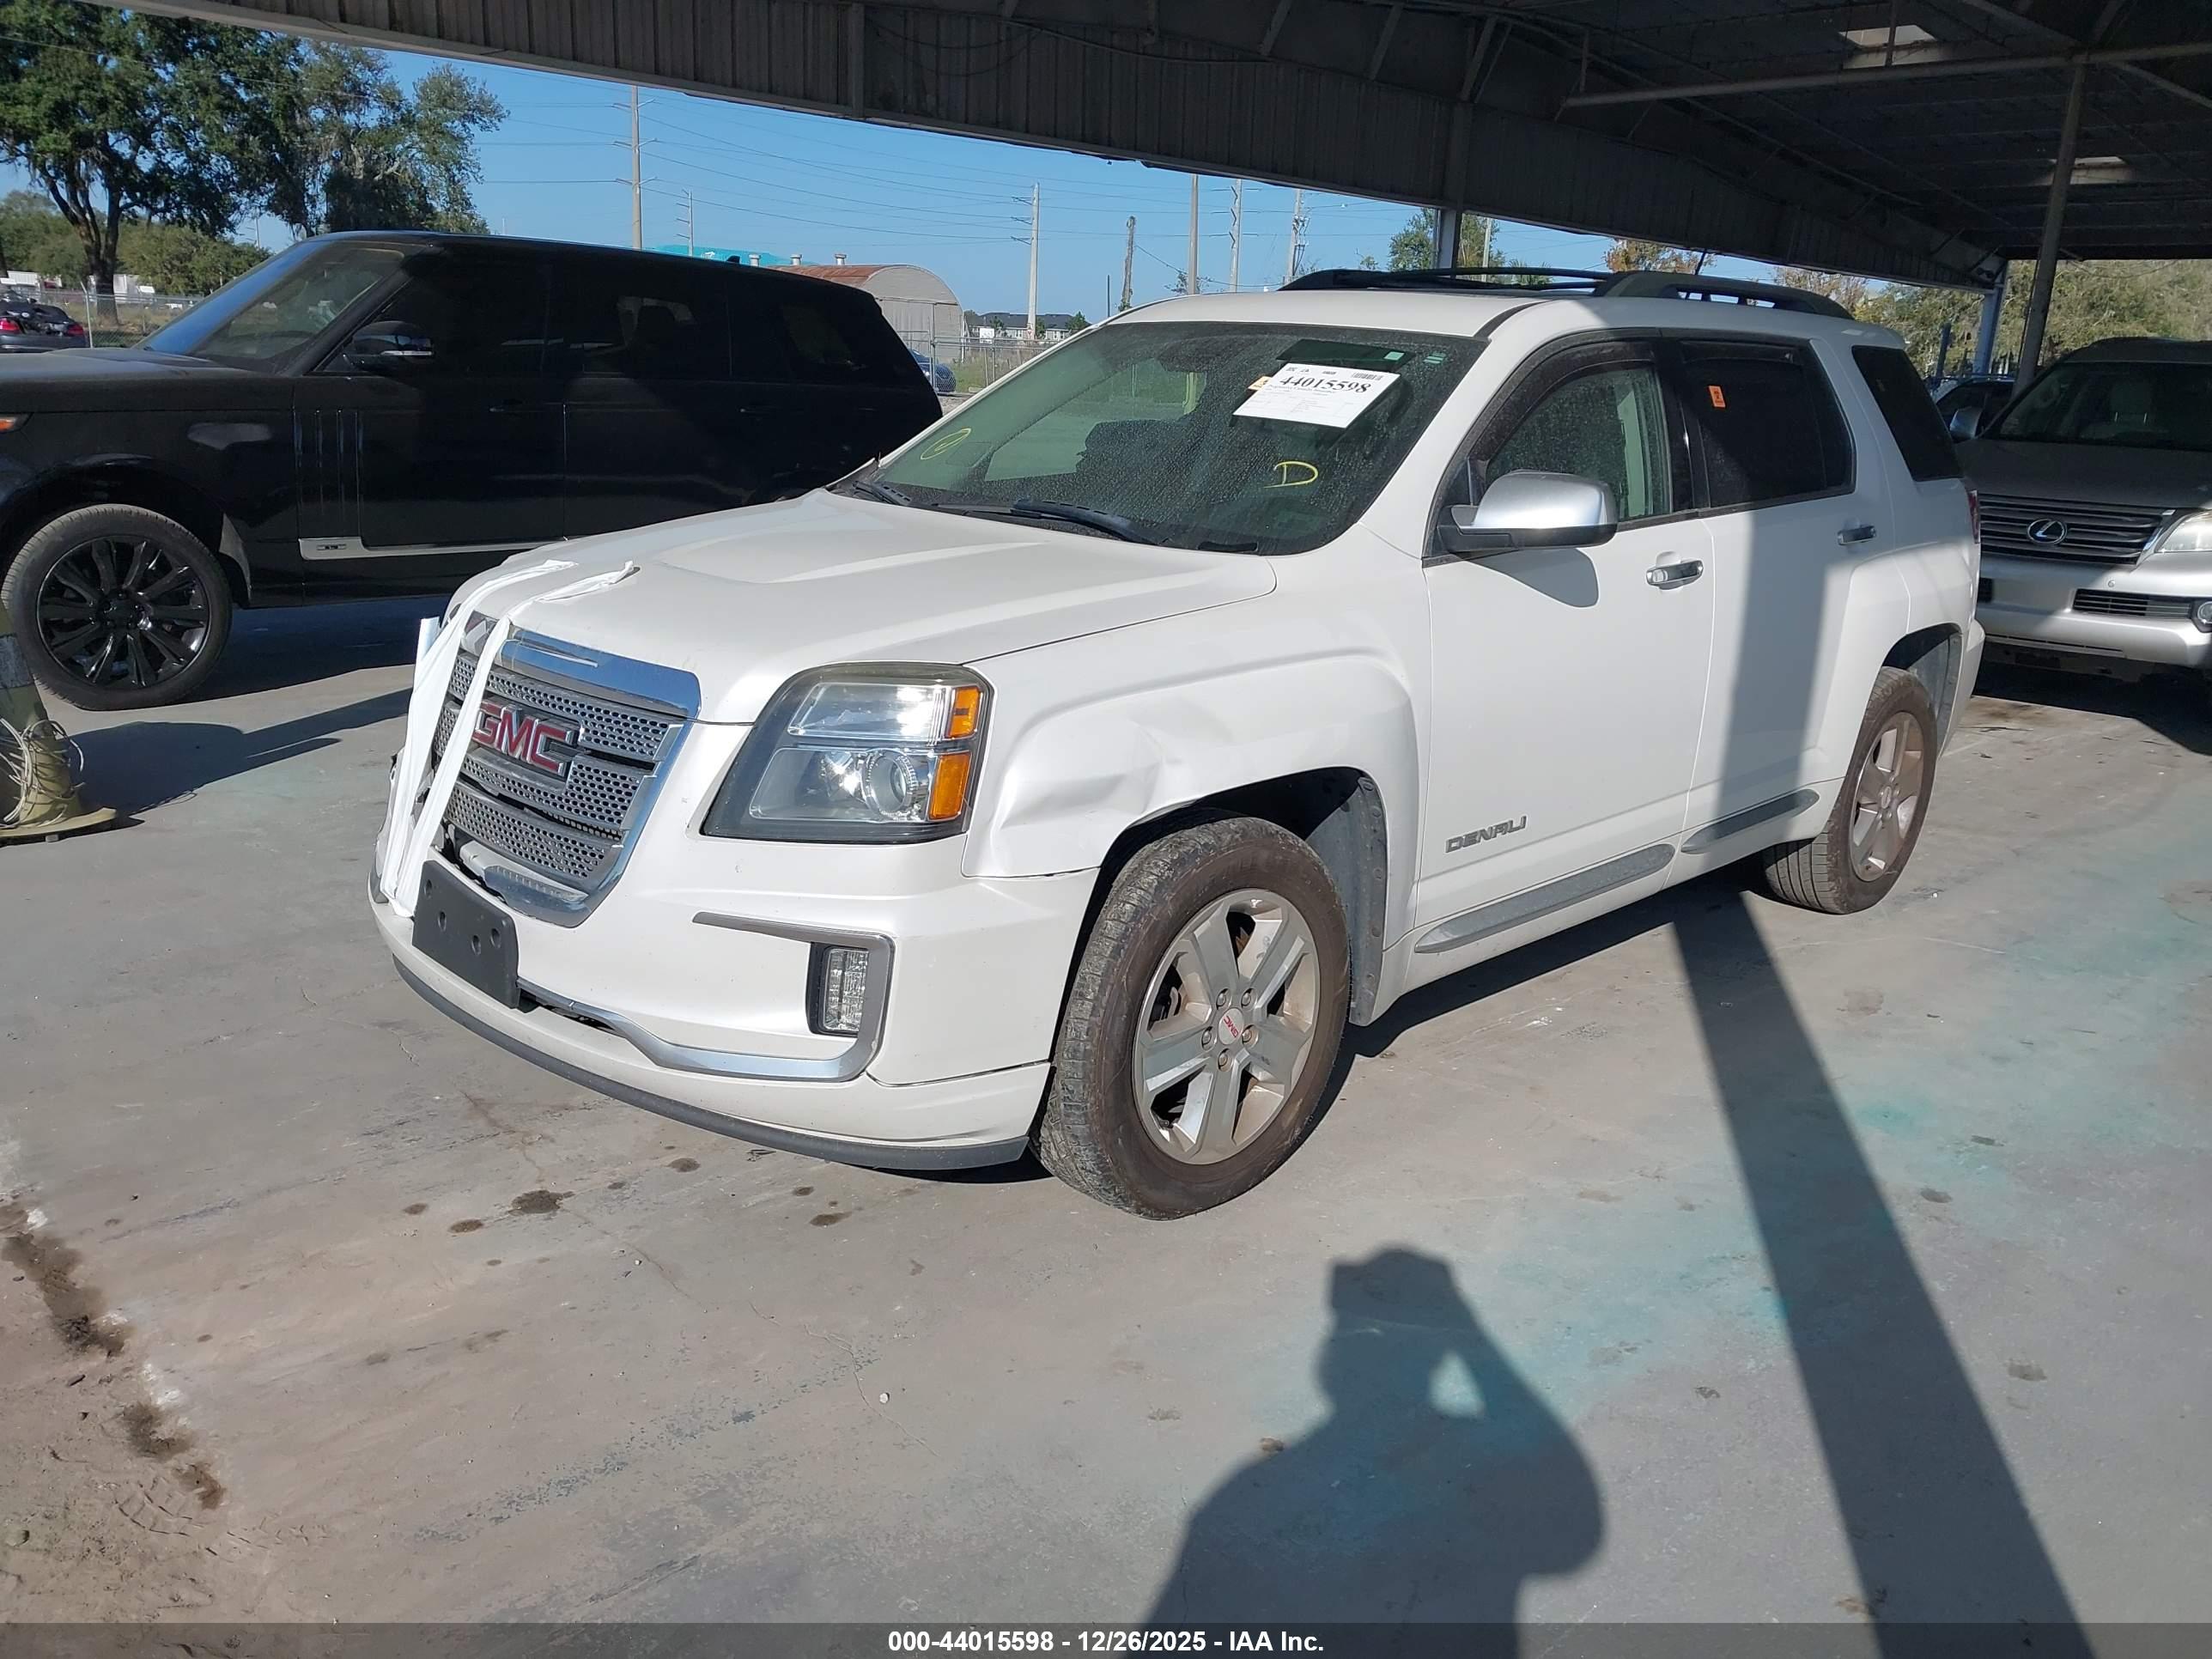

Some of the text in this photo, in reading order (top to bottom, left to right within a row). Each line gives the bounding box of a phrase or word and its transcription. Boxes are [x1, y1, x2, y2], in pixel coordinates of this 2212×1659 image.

[1279, 375, 1371, 393] 44015598
[471, 699, 574, 777] GMC
[1445, 815, 1528, 854] DENALI
[1223, 1015, 1239, 1038] GMC
